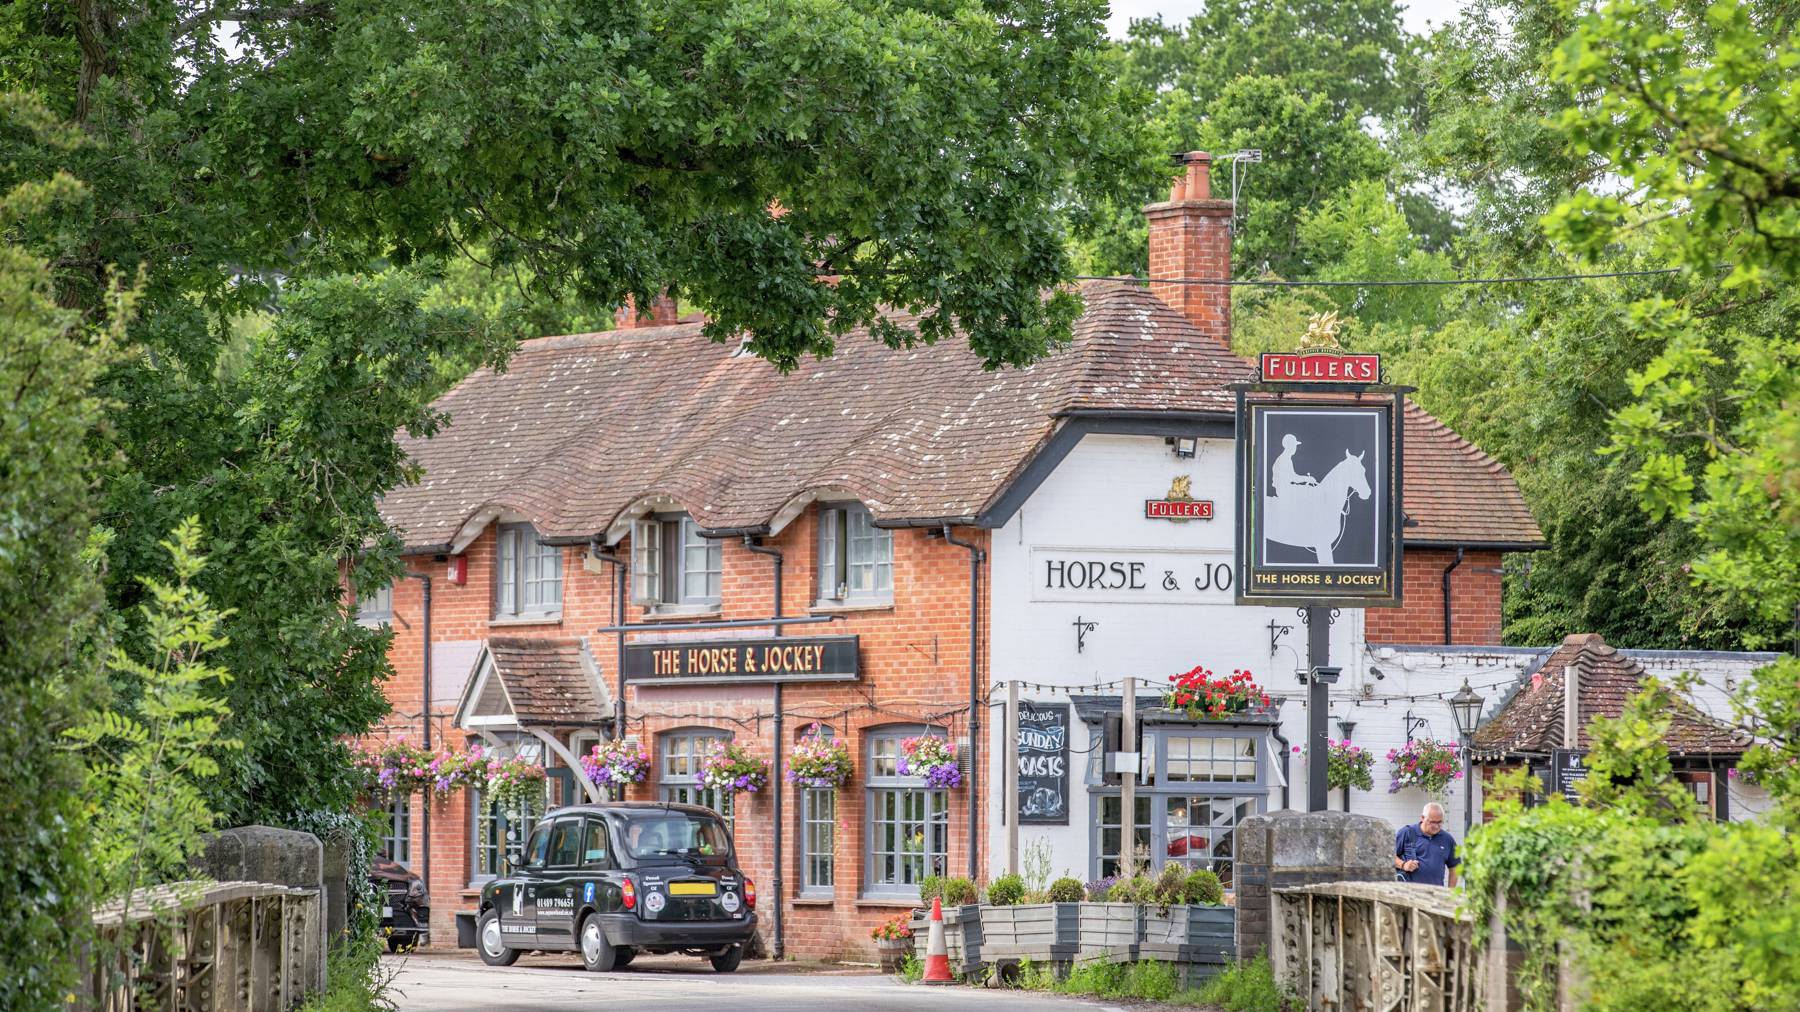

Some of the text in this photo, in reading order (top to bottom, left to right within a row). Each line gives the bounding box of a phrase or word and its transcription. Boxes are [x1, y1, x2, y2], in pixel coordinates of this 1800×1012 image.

[1269, 358, 1371, 378] FULLER'S
[1151, 503, 1209, 516] FULLER'S
[1045, 560, 1146, 590] HORSE
[1162, 570, 1181, 590] &
[1256, 574, 1381, 585] THE HORSE & JOCKEY
[653, 645, 824, 675] THE HORSE & JOCKEY
[1018, 755, 1065, 777] OASTS
